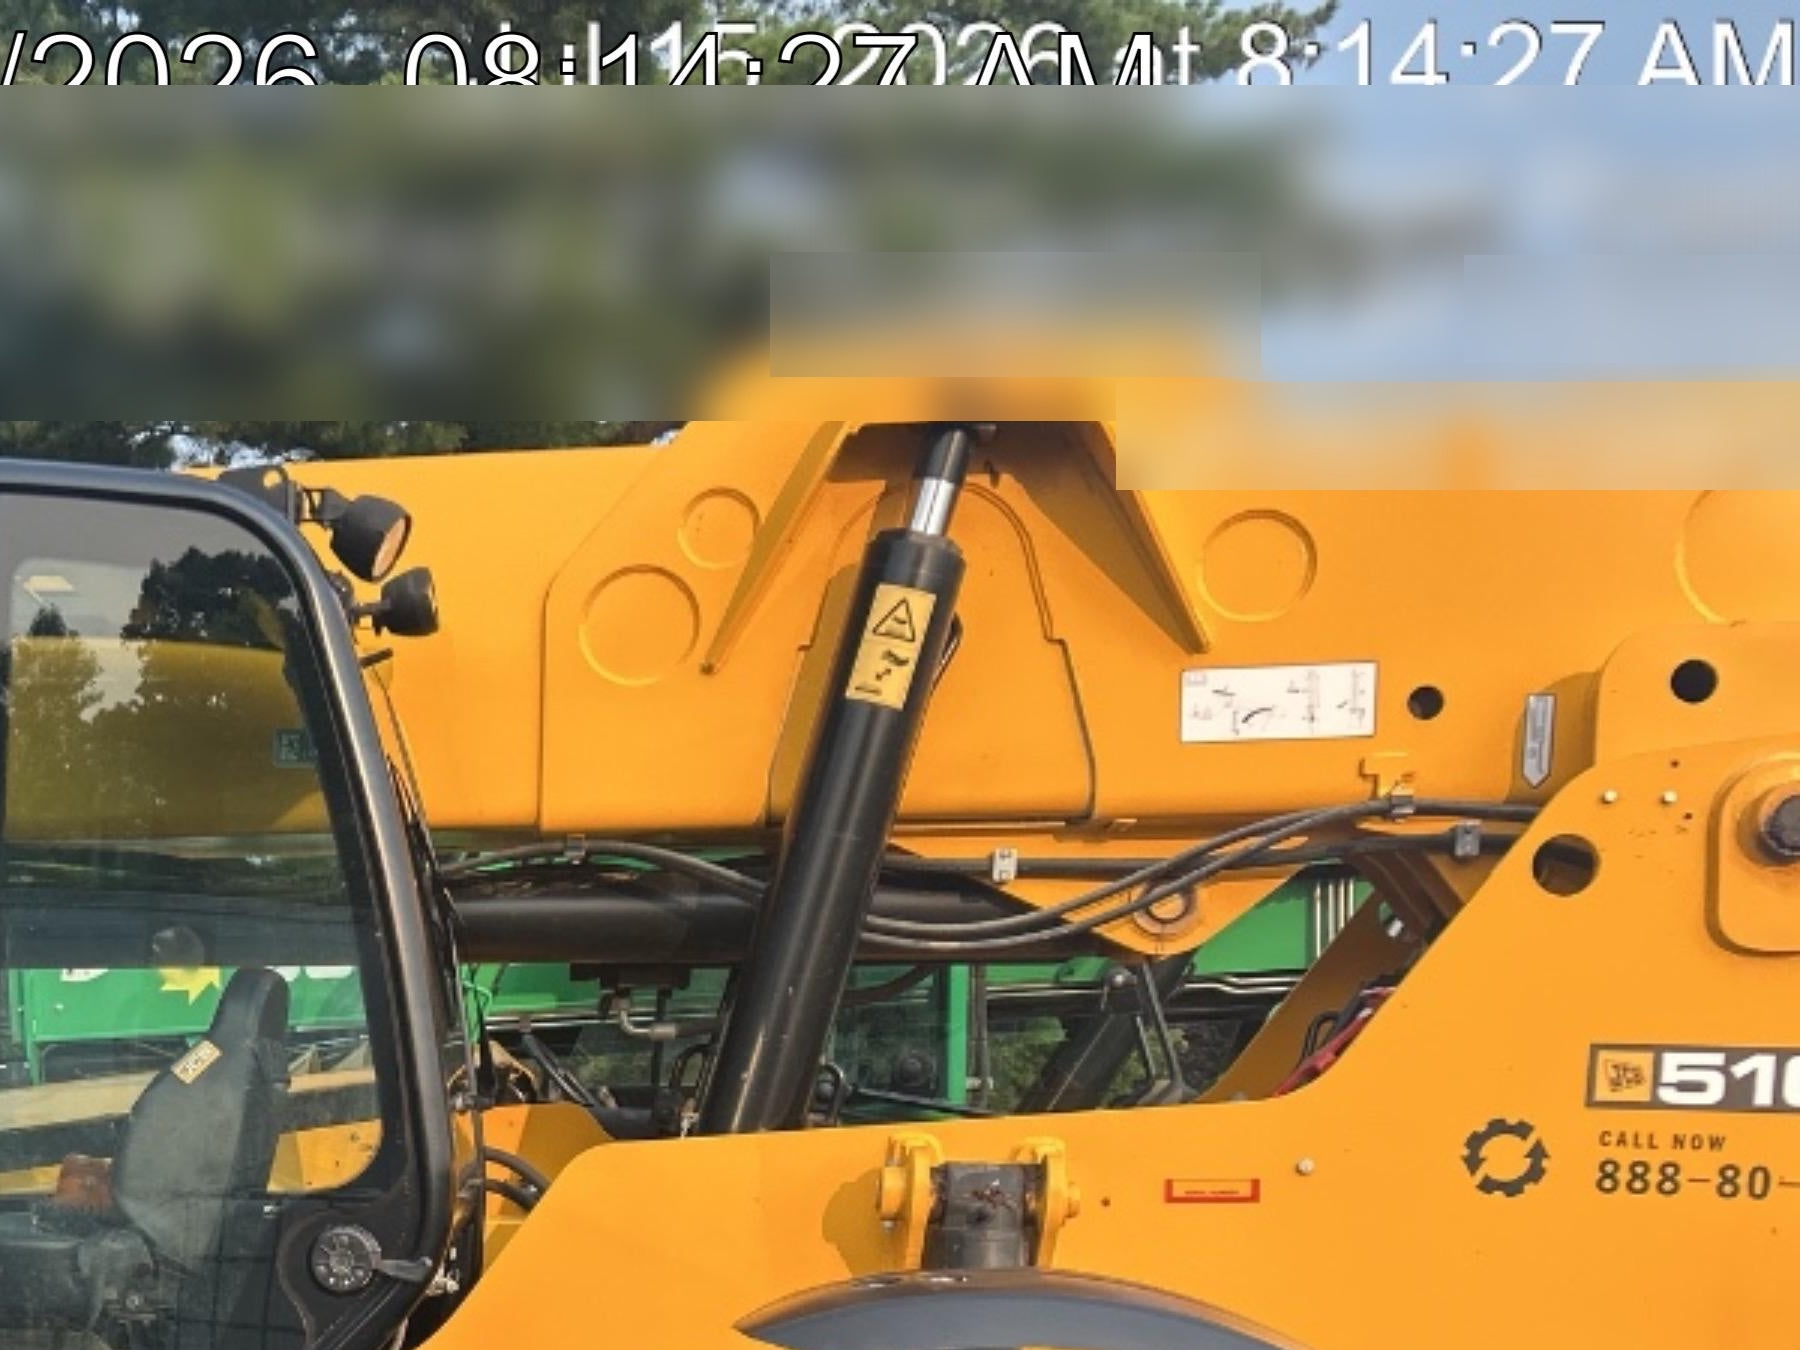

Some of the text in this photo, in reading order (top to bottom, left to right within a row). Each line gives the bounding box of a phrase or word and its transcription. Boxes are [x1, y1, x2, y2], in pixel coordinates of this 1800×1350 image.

[1656, 1052, 1800, 1108] 51
[1598, 1130, 1727, 1151] CALL NOW
